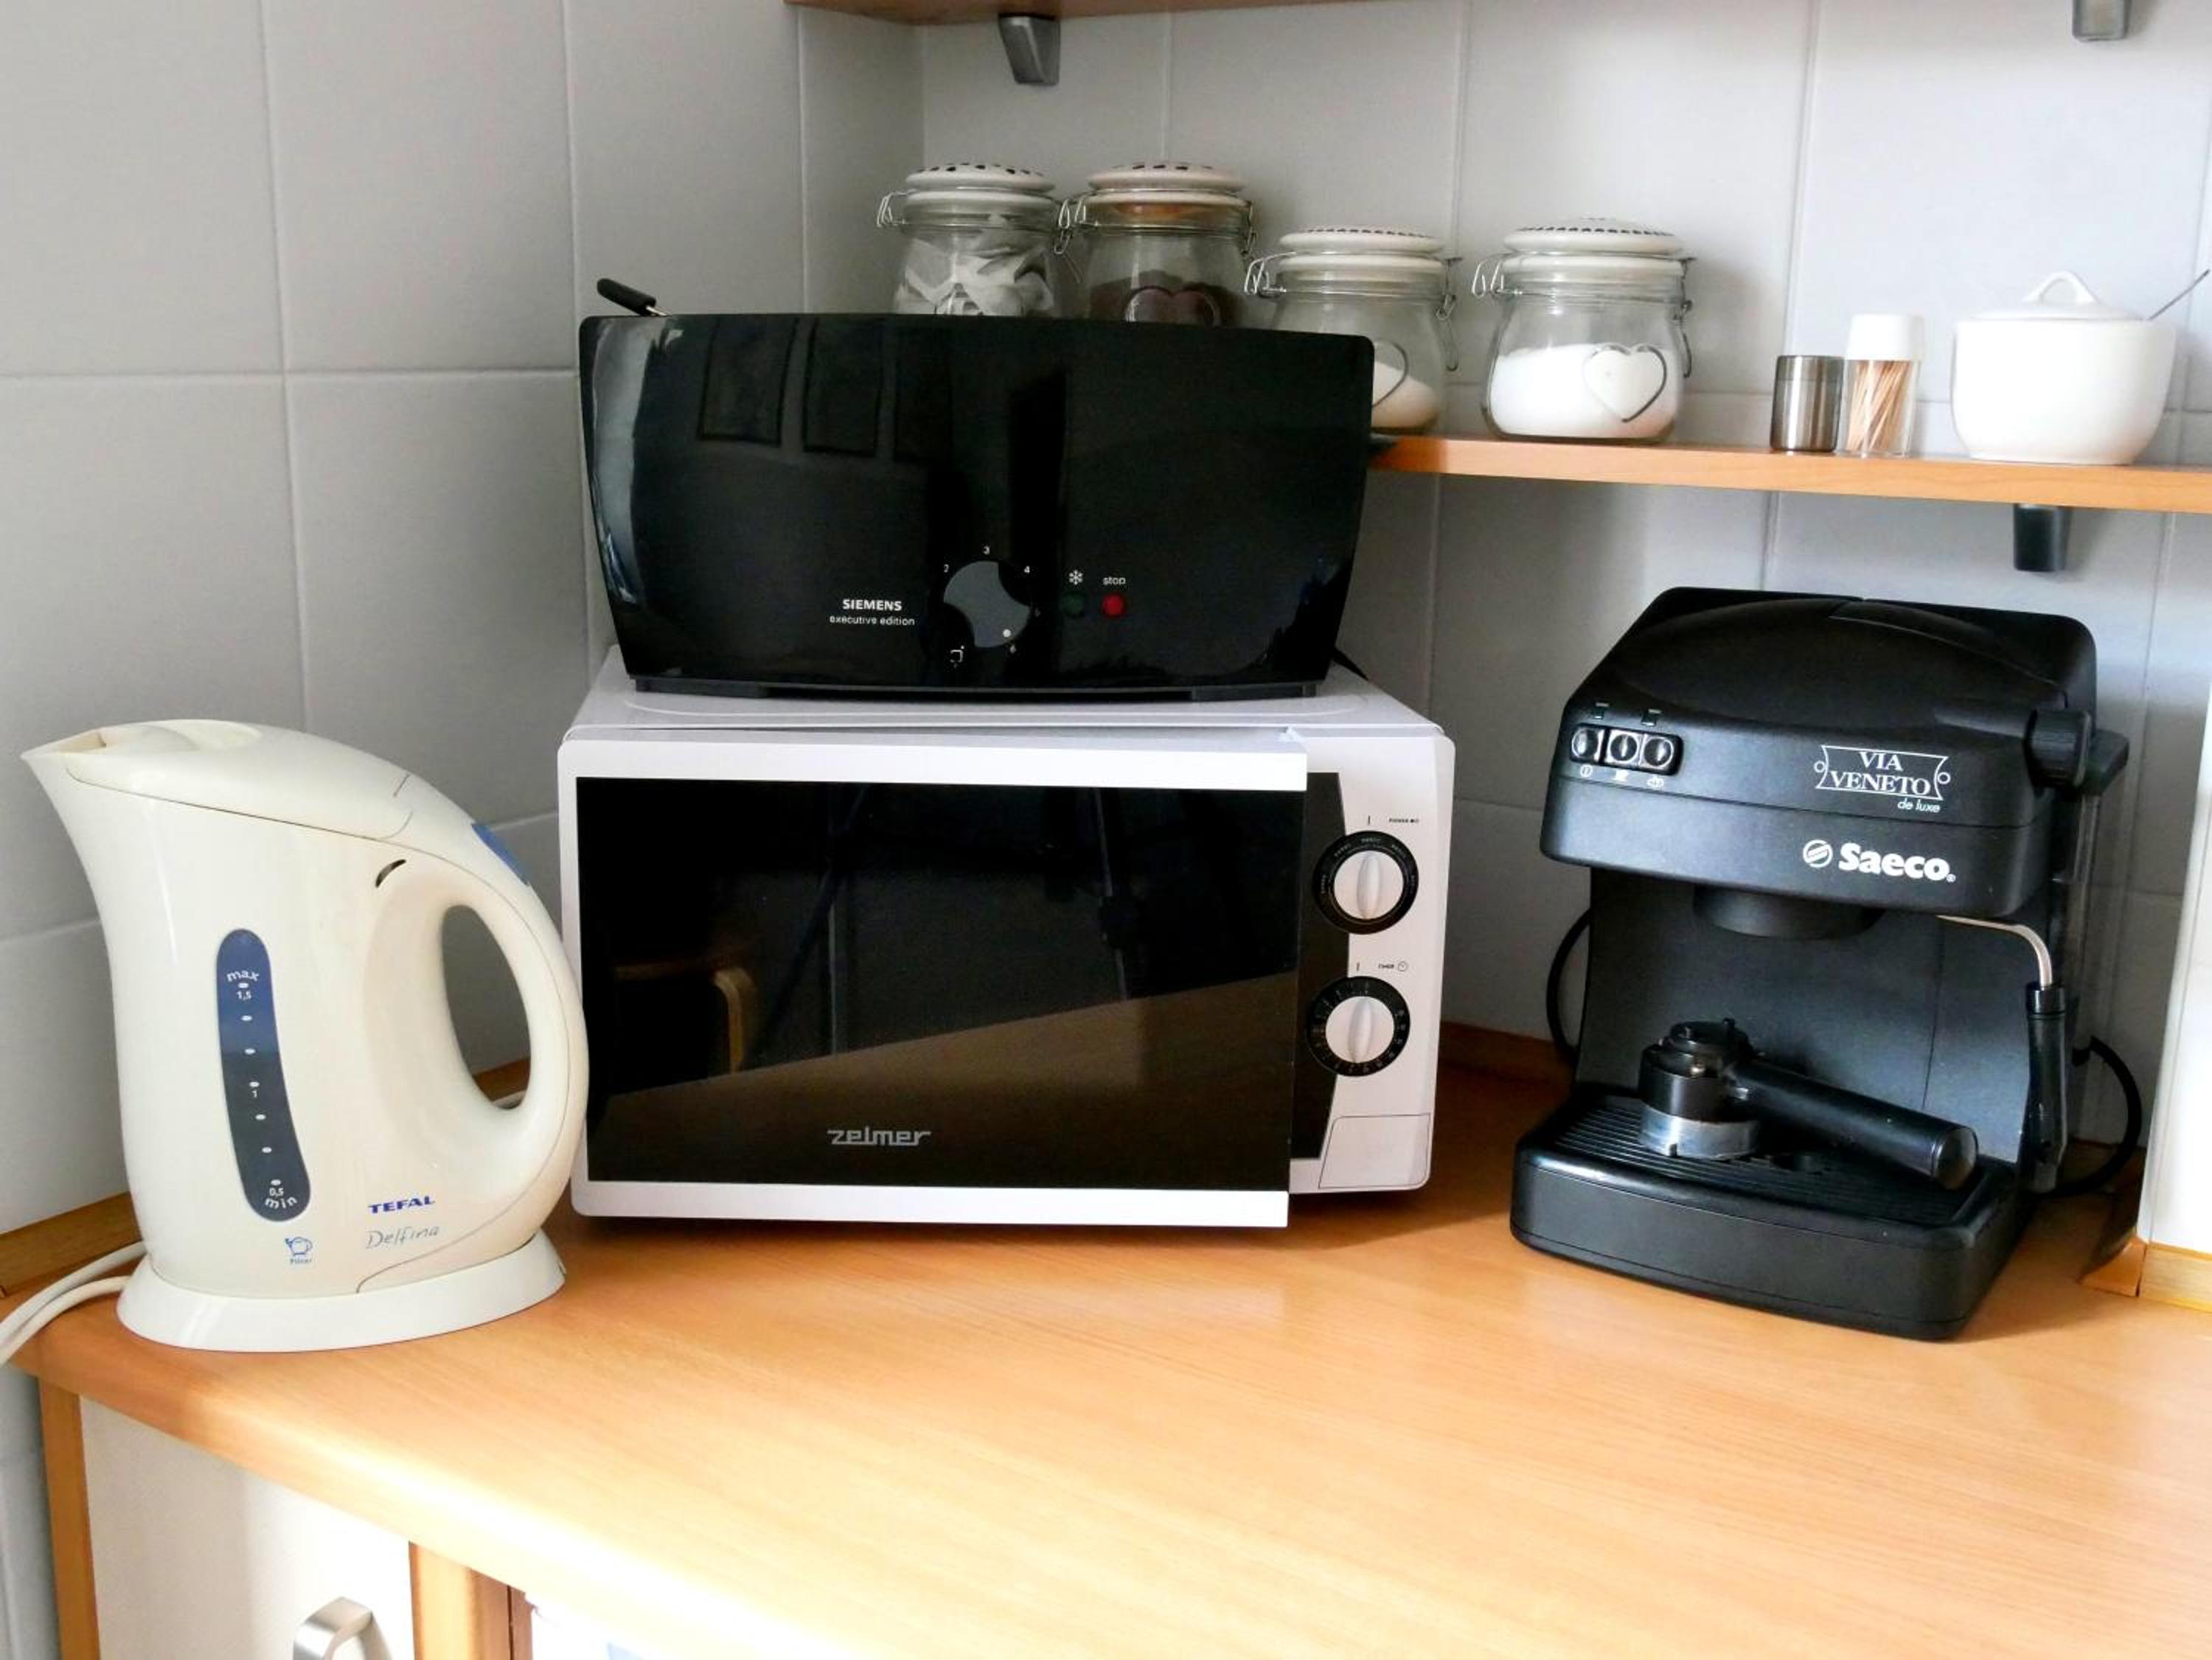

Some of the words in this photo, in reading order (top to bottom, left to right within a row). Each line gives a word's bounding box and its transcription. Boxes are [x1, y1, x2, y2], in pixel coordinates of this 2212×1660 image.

[983, 545, 991, 555] 3
[943, 563, 950, 573] 2
[1023, 565, 1031, 574] 4
[1103, 576, 1126, 586] stop
[842, 599, 902, 611] SIEMENS
[830, 615, 877, 624] executive
[880, 616, 915, 626] edition
[1860, 751, 1904, 772] VIA
[1830, 770, 1931, 796] VENETO
[1897, 798, 1914, 810] de
[1915, 799, 1941, 813] luxe
[226, 970, 260, 981] max
[827, 1126, 931, 1146] zelmer
[265, 1196, 297, 1209] min
[367, 1196, 436, 1213] TEFAL
[366, 1226, 439, 1249] Delfina
